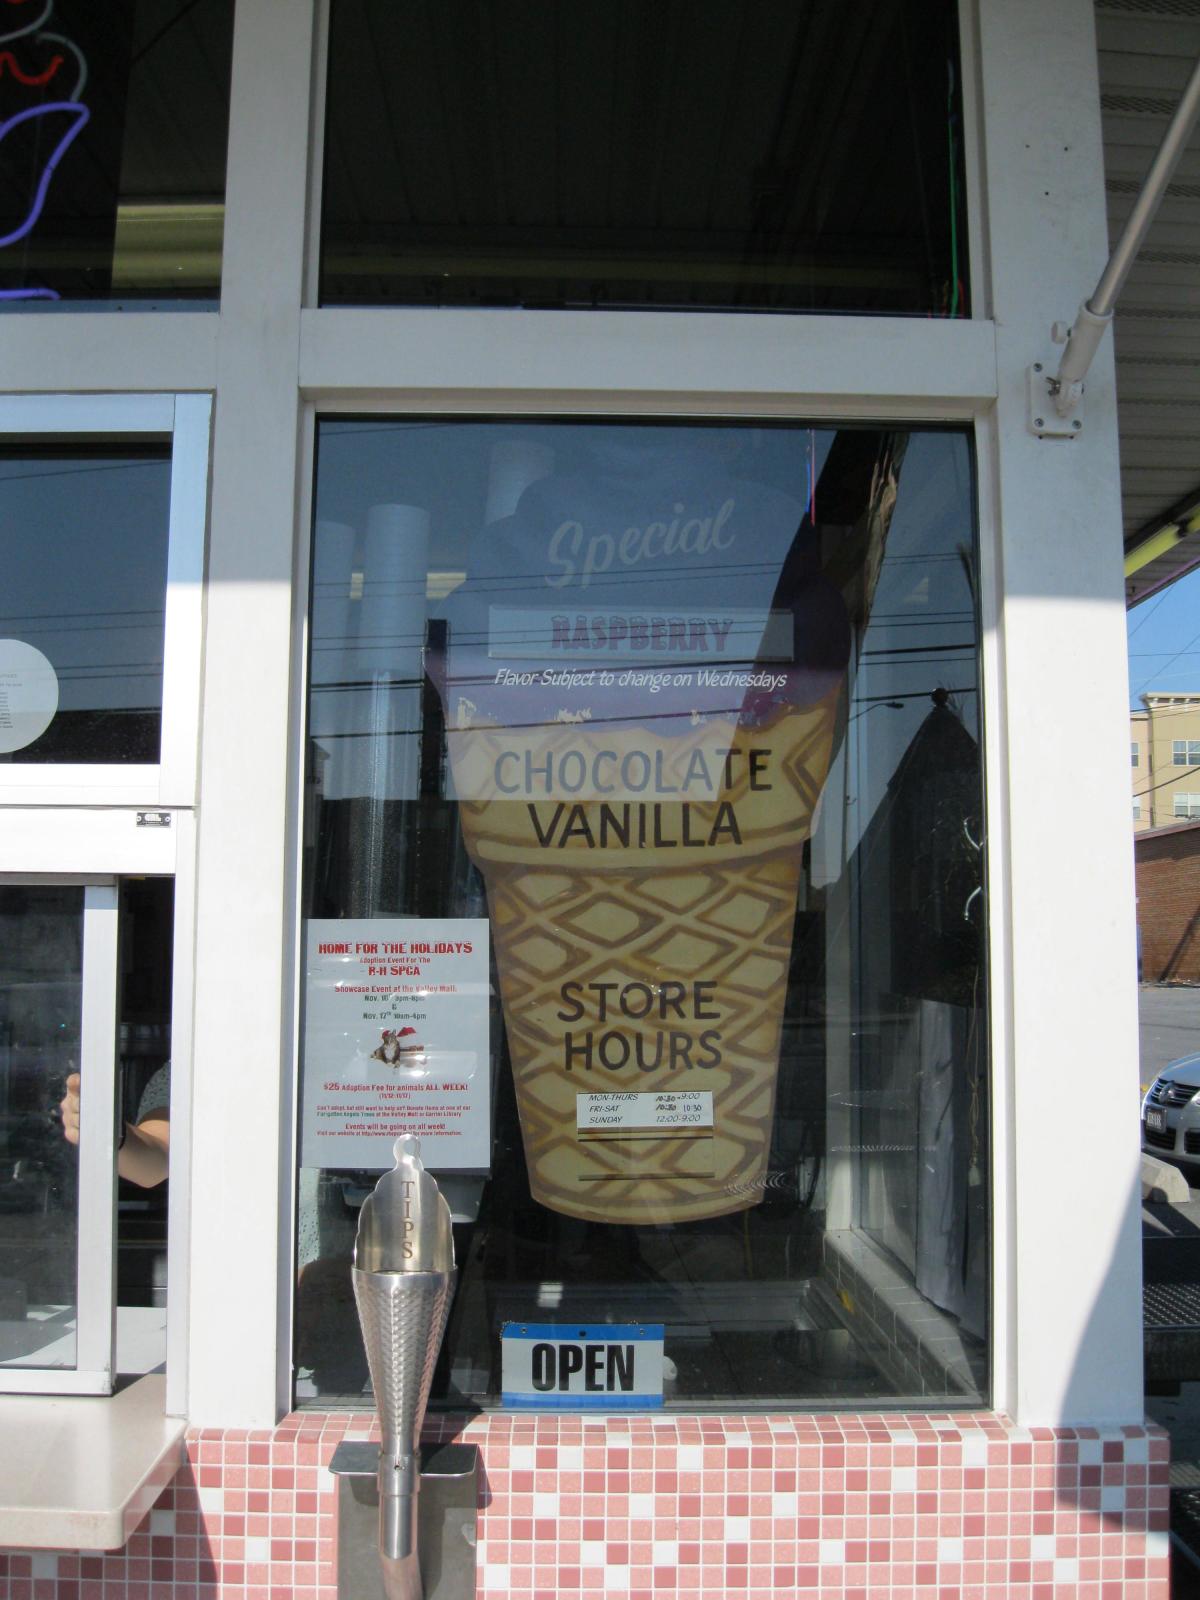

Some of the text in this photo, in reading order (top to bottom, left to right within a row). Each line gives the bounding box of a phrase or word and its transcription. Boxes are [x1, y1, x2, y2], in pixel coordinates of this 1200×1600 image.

[544, 499, 736, 589] Special
[551, 615, 734, 651] RASPBERRY
[494, 668, 787, 692] Flavor Subject to change on Wednesdays
[494, 749, 772, 794] CHOCOLATE
[527, 801, 743, 849] VANILLA
[319, 942, 473, 954] HOME FOR THE HOLIDAYS
[368, 966, 421, 976] R-H SPCA
[335, 985, 370, 993] Showcase
[371, 985, 391, 993] Event
[393, 985, 401, 993] at
[402, 985, 414, 993] the
[415, 985, 438, 994] Valley
[557, 981, 721, 1022] STORE
[565, 1030, 722, 1073] HOURS
[341, 1084, 370, 1092] Adoption
[442, 1083, 468, 1091] WEEK!
[589, 1093, 638, 1101] MON-THURS
[589, 1104, 621, 1113] FRI-SAT
[589, 1115, 623, 1124] SUNDAY
[389, 1123, 406, 1131] going
[401, 1181, 415, 1259] TIPS
[532, 1343, 634, 1391] OPEN
